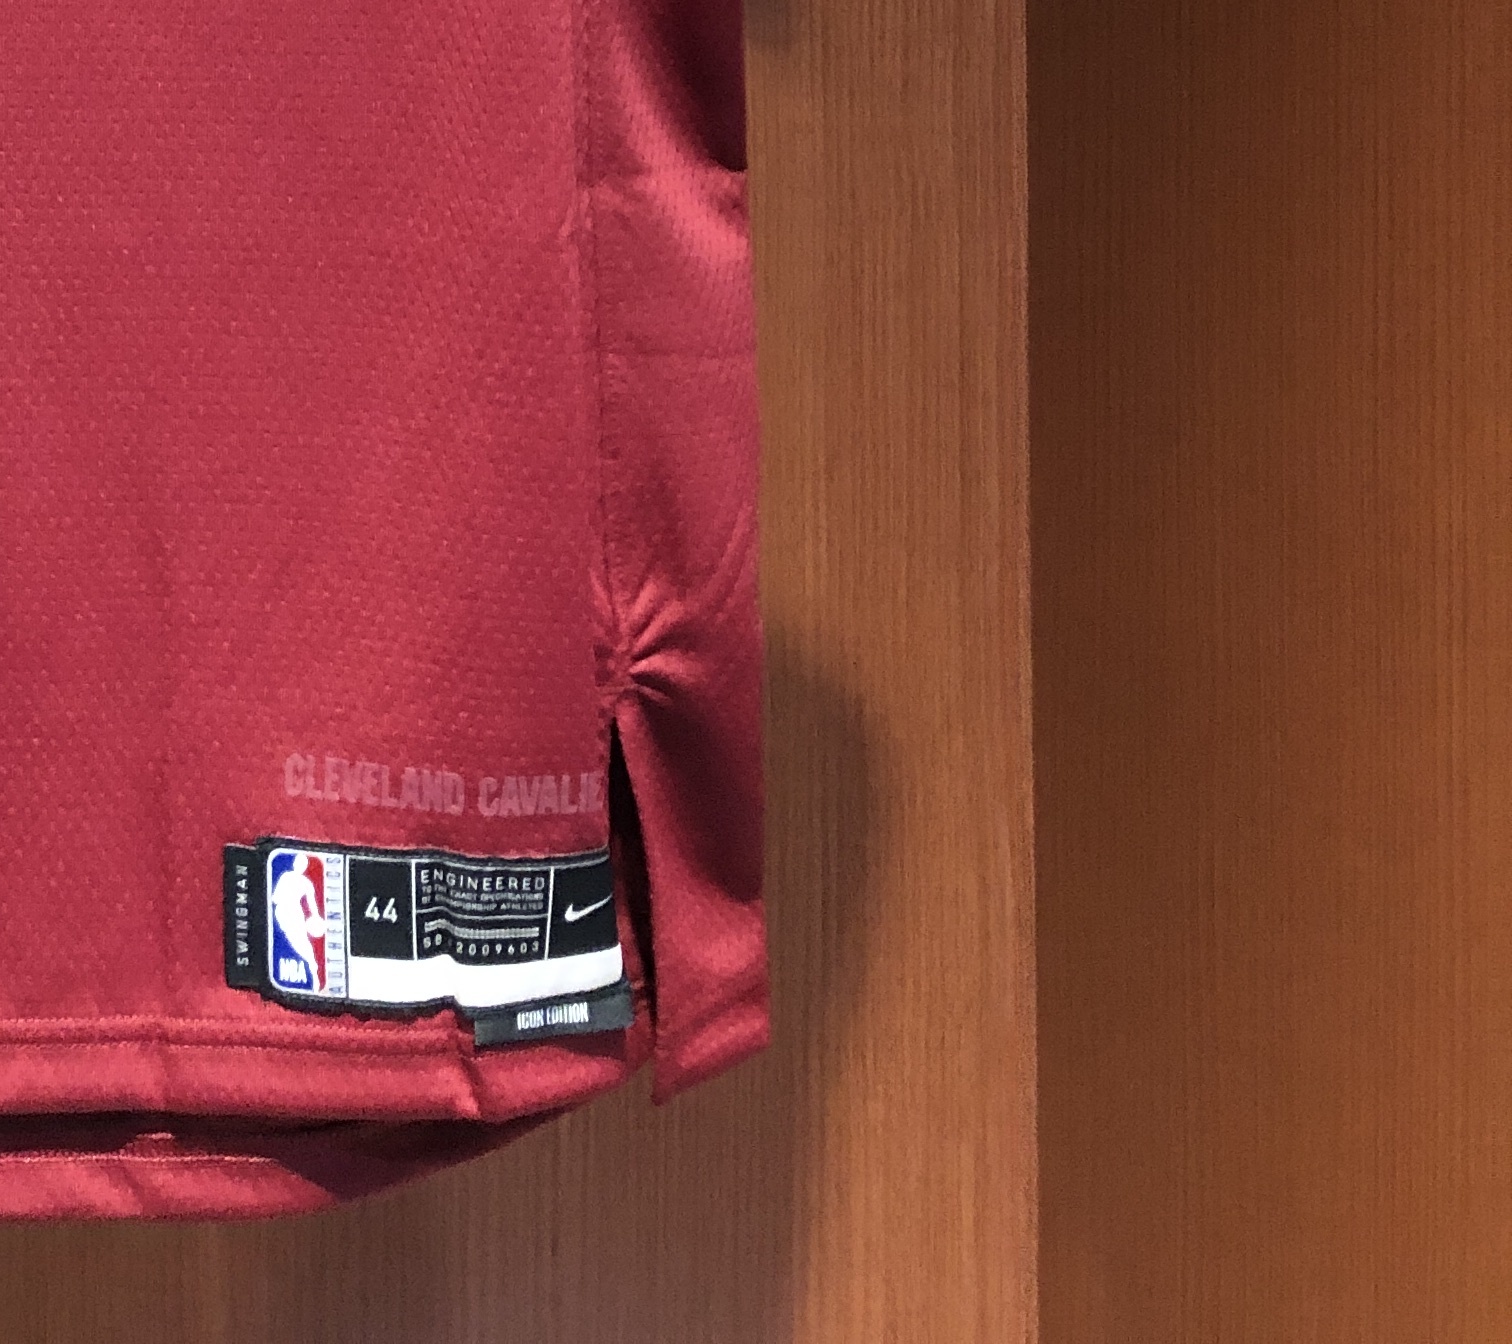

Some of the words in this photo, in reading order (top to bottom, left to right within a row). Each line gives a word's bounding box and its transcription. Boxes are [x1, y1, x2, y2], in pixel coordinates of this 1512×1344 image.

[284, 753, 465, 816] CLEVELAND
[420, 868, 546, 892] ENGINEERED
[235, 864, 250, 967] SWINGMAN
[364, 896, 399, 924] 44
[326, 857, 344, 995] AUTHENTICS
[279, 957, 308, 984] NBA
[516, 1008, 545, 1031] ICON
[546, 1001, 589, 1026] EDITION
